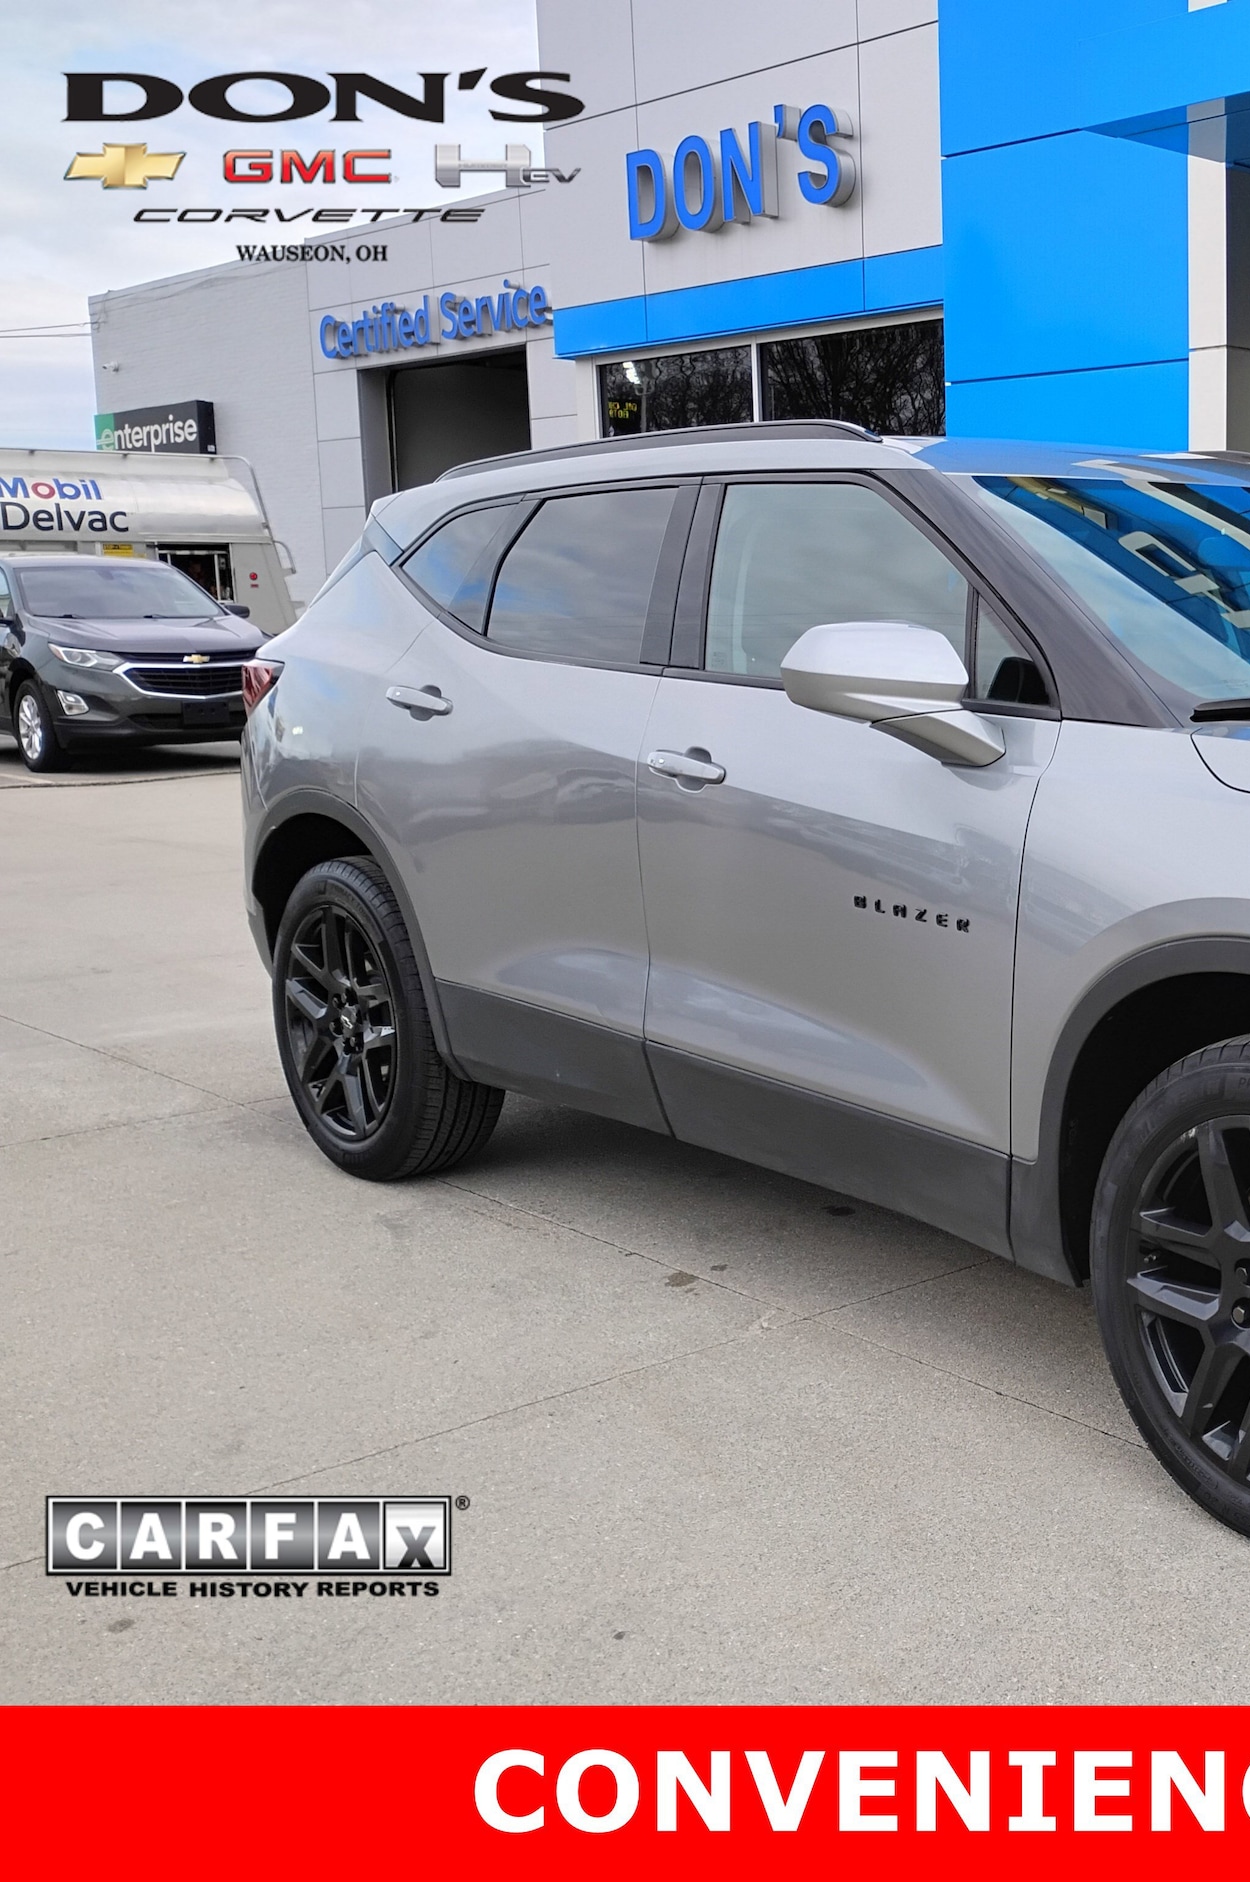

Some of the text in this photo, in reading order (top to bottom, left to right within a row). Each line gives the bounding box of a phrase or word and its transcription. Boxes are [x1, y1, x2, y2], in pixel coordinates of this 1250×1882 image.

[626, 103, 852, 243] DON'S
[320, 279, 550, 360] Certified Service
[97, 414, 198, 453] enterprise
[0, 477, 103, 501] Mobil
[0, 501, 129, 533] Delvac
[854, 895, 970, 933] BLAZER
